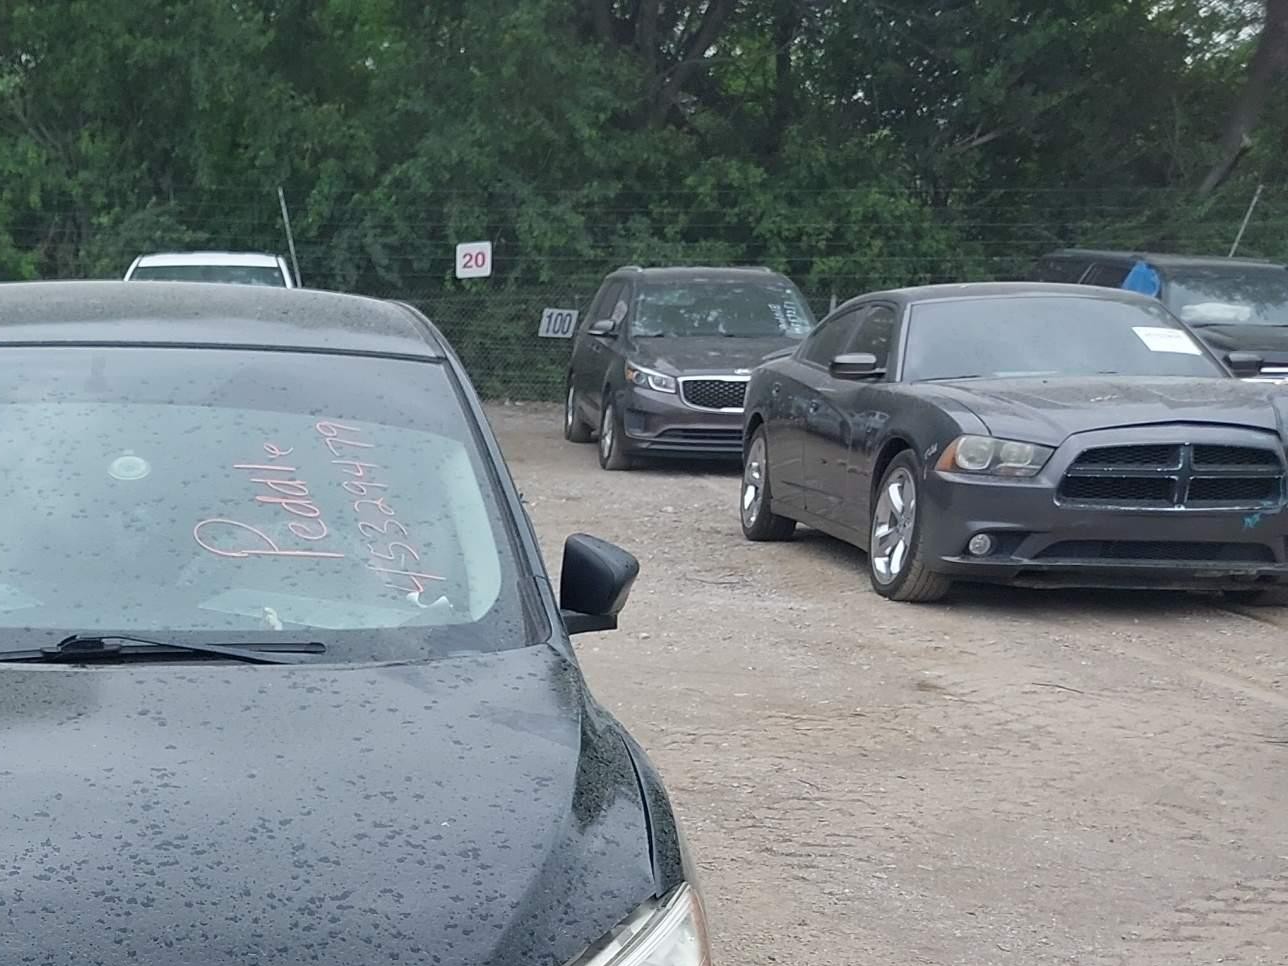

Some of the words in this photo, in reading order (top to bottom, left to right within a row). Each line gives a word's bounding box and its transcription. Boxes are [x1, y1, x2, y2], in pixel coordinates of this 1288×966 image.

[462, 251, 486, 269] 20
[545, 312, 572, 335] 100
[193, 442, 345, 558] Peddle
[316, 420, 447, 593] 45329479
